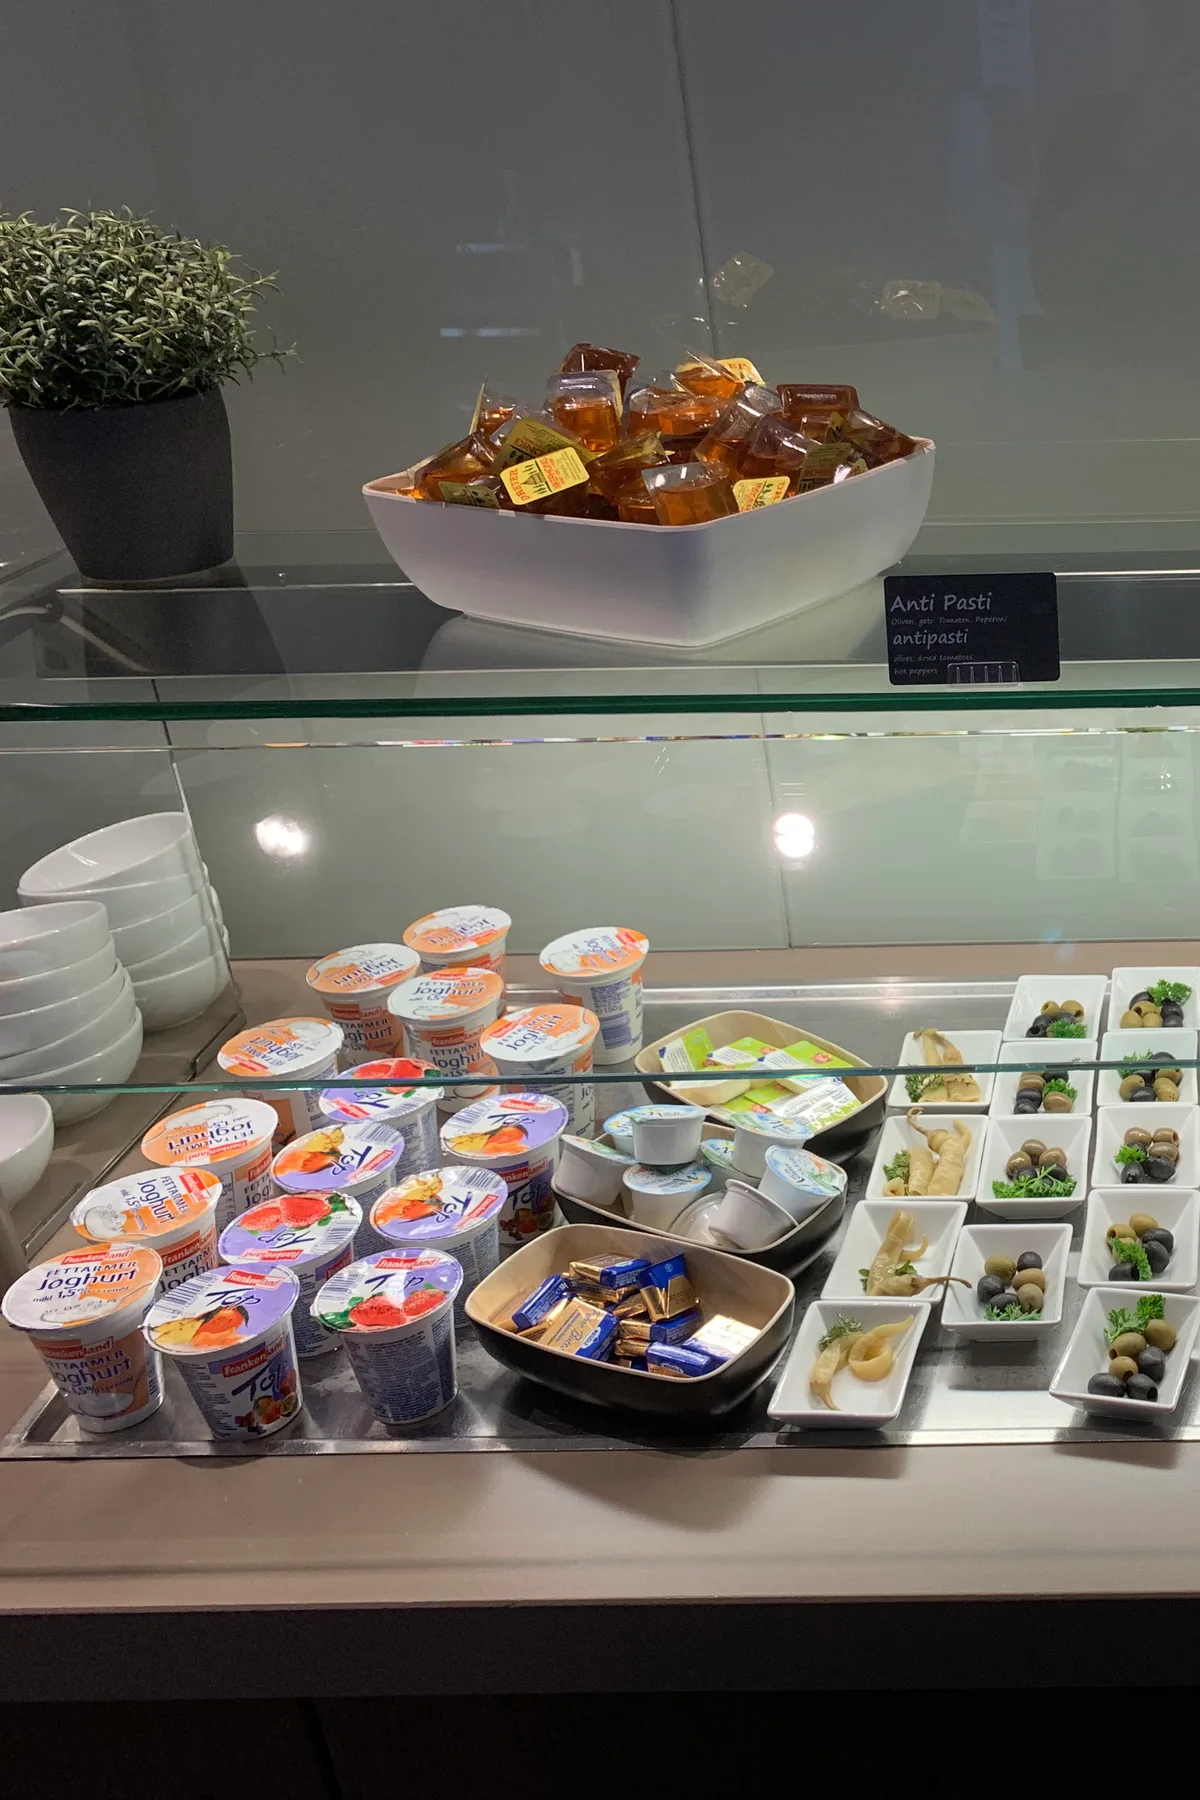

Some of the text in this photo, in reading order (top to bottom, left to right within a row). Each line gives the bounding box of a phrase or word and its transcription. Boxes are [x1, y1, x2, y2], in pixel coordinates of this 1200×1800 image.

[509, 468, 531, 501] DREYER
[890, 592, 993, 612] Anti Pasti
[975, 615, 1008, 624] Peperoni
[893, 628, 969, 649] antipasti
[894, 667, 938, 677] hot peppers
[413, 986, 484, 996] Joghurt
[343, 1026, 393, 1044] oghurt
[506, 1014, 563, 1051] Joghurt
[249, 1037, 304, 1061] Joghurt
[429, 1042, 480, 1056] FETTARM
[501, 1100, 550, 1112] Frankenland
[487, 1112, 536, 1126] Top
[167, 1119, 254, 1151] Joghurt
[173, 1130, 254, 1155] FETTARMER
[187, 1140, 247, 1161] Frankenland
[331, 1145, 373, 1175] Top
[244, 1173, 270, 1194] FETTA
[137, 1178, 176, 1224] Joghurt
[160, 1175, 190, 1214] FETTARMER
[507, 1180, 548, 1211] Top
[435, 1191, 473, 1223] Top
[258, 1229, 316, 1249] Top
[63, 1249, 131, 1264] Frankenland
[165, 1246, 211, 1277] ETTARM
[243, 1250, 302, 1260] Frankenland
[378, 1258, 436, 1269] Frankenland
[36, 1268, 138, 1290] Joghurt
[46, 1261, 137, 1277] FETTARMER
[227, 1271, 281, 1290] Frankenland
[365, 1272, 424, 1292] Tp
[32, 1295, 53, 1303] mild
[205, 1288, 261, 1311] Top
[561, 1328, 584, 1352] Butte
[223, 1336, 284, 1377] Frankenland
[54, 1359, 131, 1387] oghurt
[232, 1360, 287, 1402] Top
